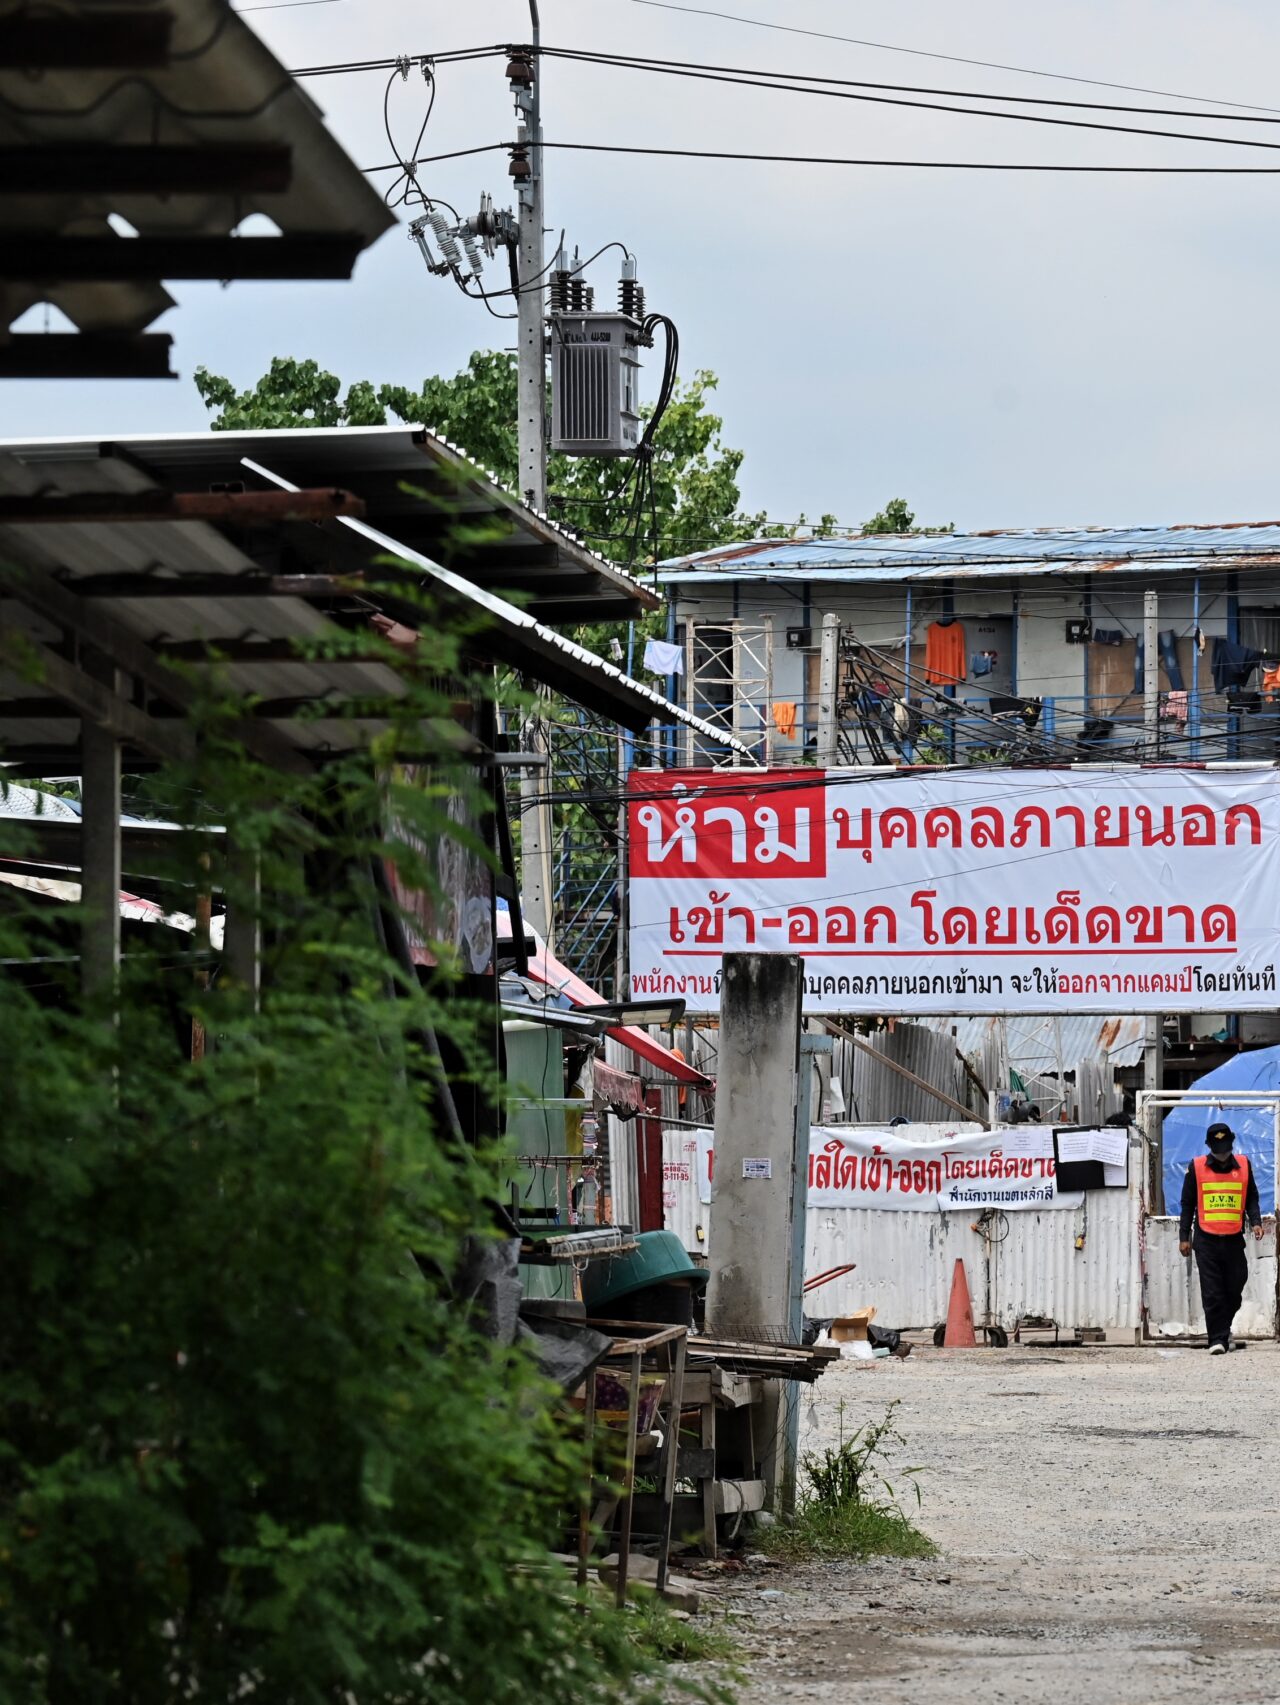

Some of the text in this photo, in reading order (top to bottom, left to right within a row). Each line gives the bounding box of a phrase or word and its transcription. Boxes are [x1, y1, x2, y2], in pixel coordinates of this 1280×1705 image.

[637, 782, 1261, 863] ห้าม บุคคลภายนอก
[670, 890, 1238, 945] เข้า-ออก โดยเด็ดขาด
